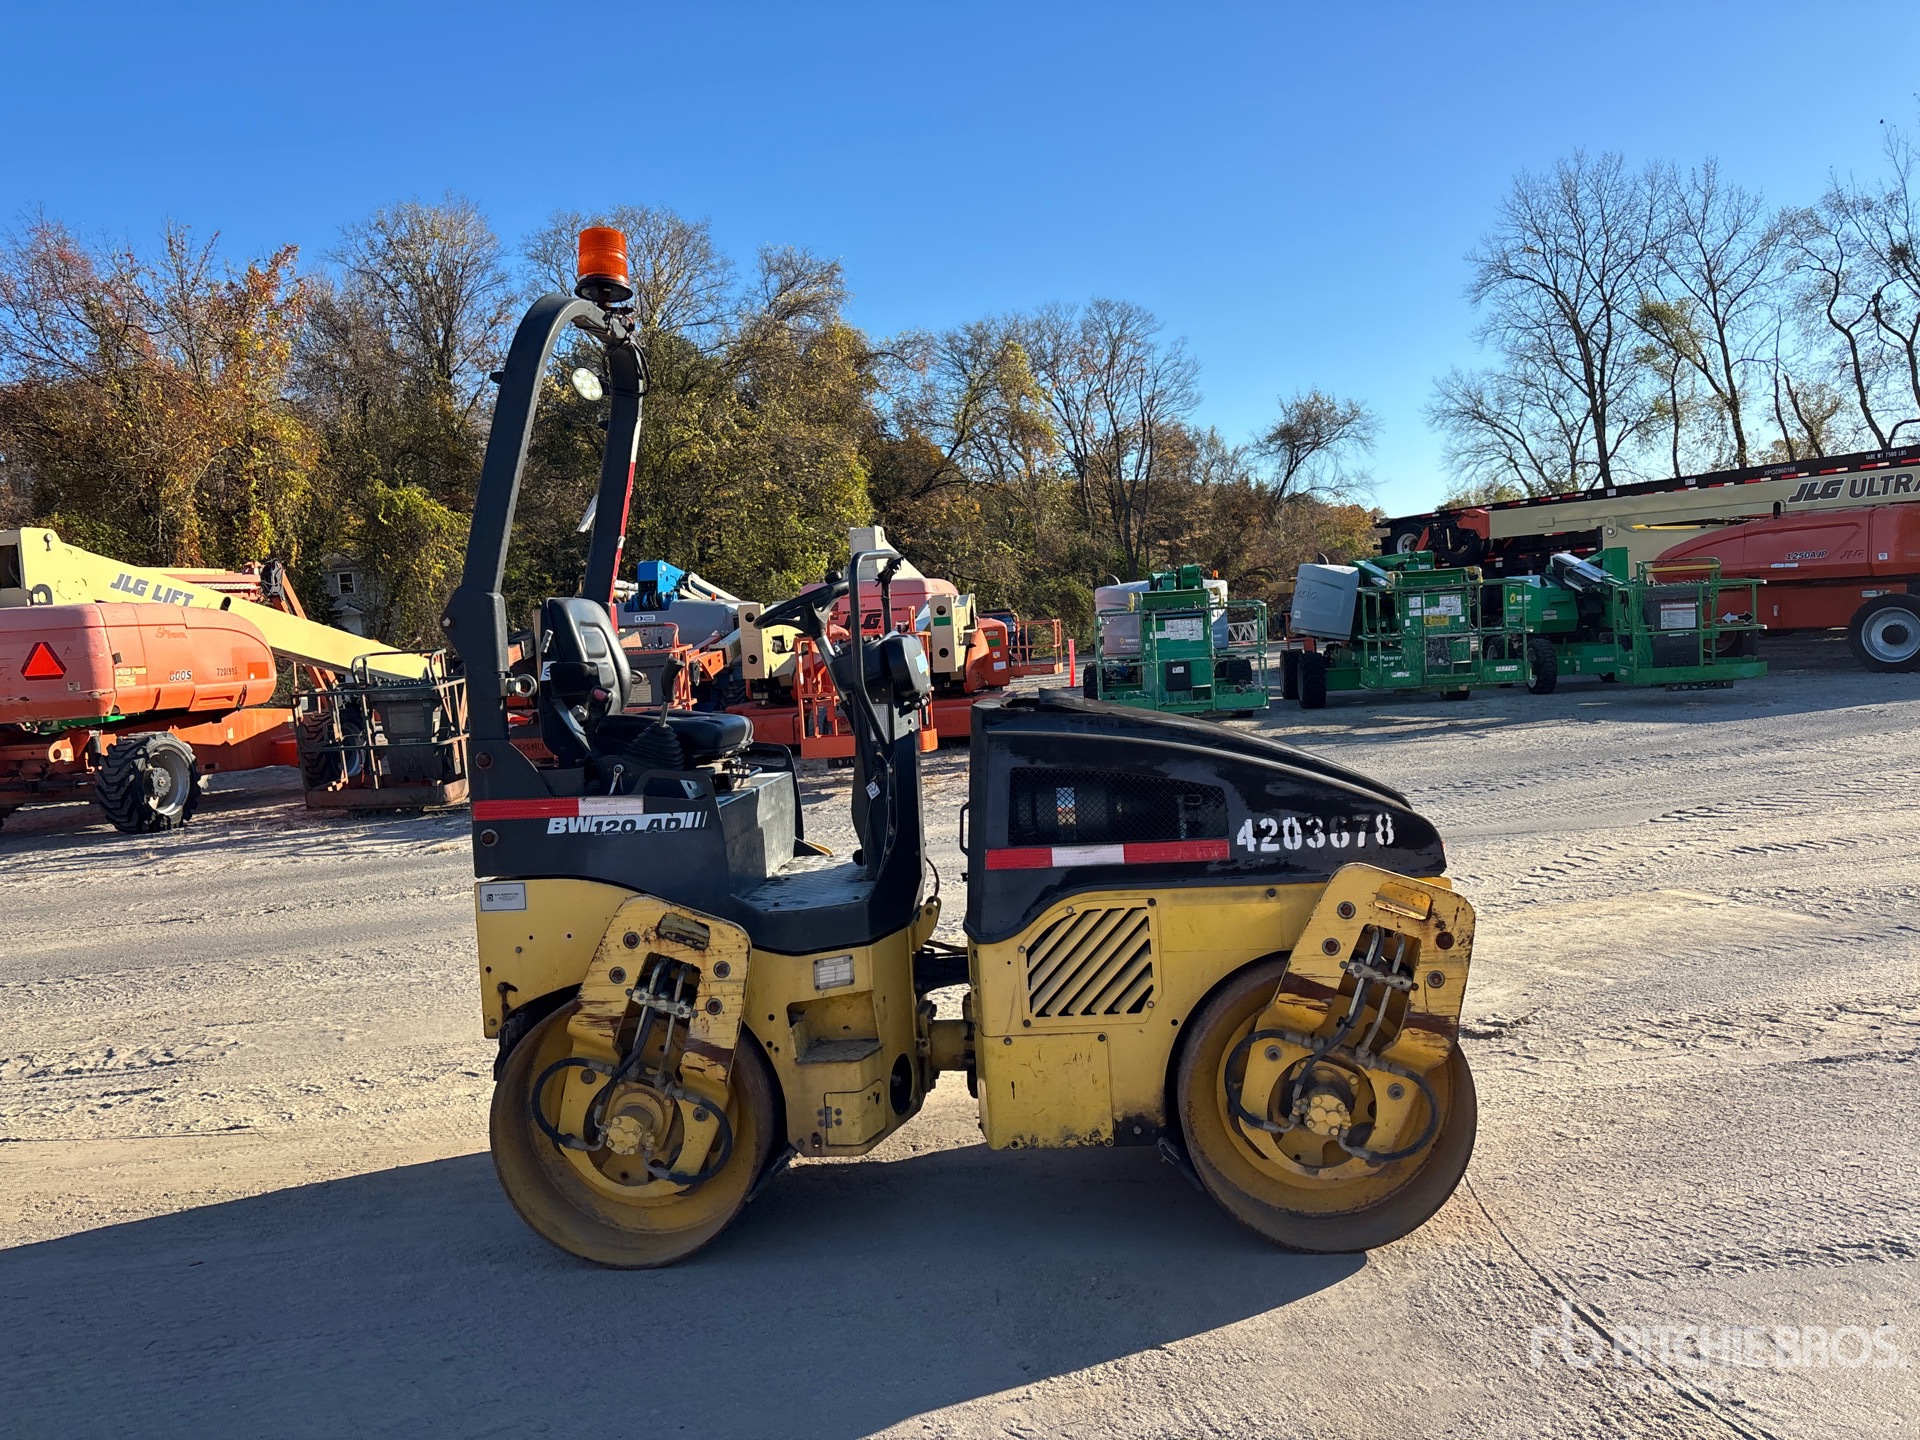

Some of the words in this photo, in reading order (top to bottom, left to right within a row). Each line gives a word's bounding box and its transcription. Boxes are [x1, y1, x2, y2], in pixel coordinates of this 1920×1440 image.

[1787, 479, 1846, 504] JLG
[1785, 550, 1828, 560] 1250AJP
[110, 573, 149, 597] JLG
[152, 584, 194, 607] LIFT
[1236, 812, 1396, 852] 4203678
